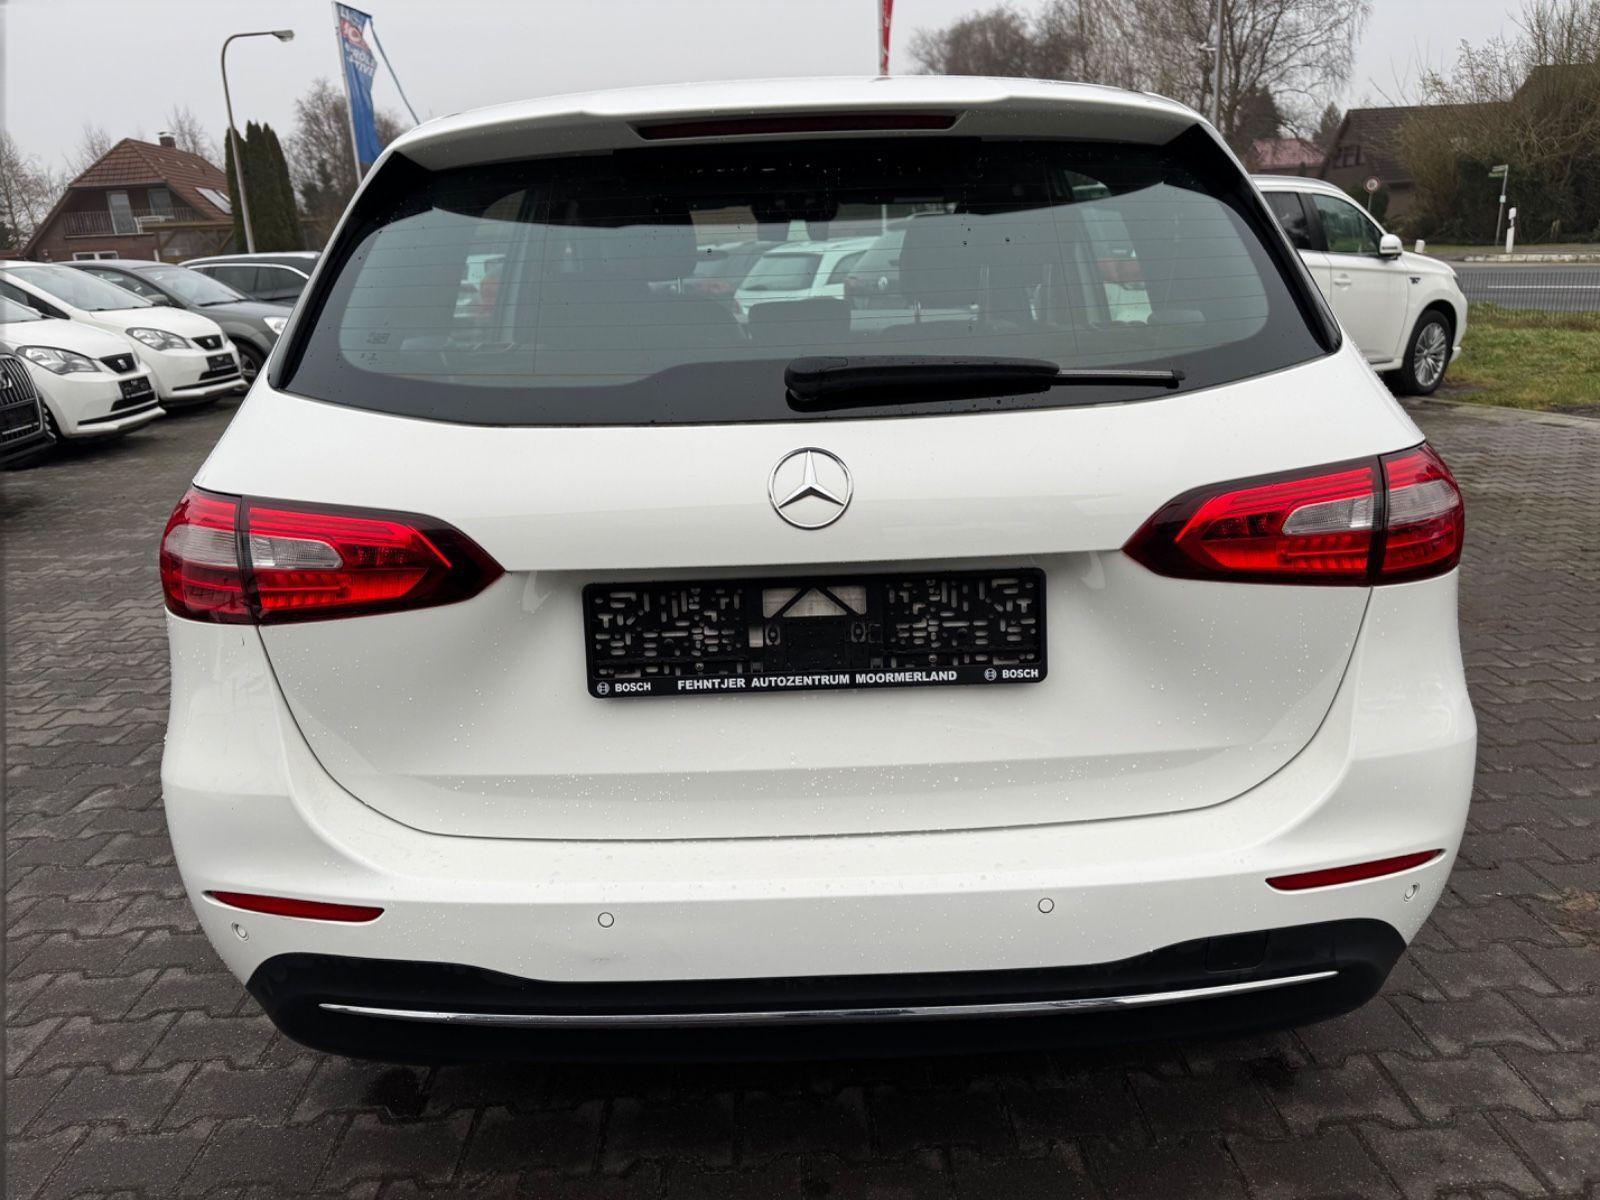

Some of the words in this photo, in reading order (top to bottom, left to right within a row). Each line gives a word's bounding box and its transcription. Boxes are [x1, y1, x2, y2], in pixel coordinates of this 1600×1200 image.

[1002, 668, 1039, 679] BOSCH
[677, 678, 746, 691] FEHNTJER
[751, 673, 850, 688] AUTOZENTRUM
[855, 670, 958, 685] MOORMERLAND
[614, 681, 652, 692] BOSCH
